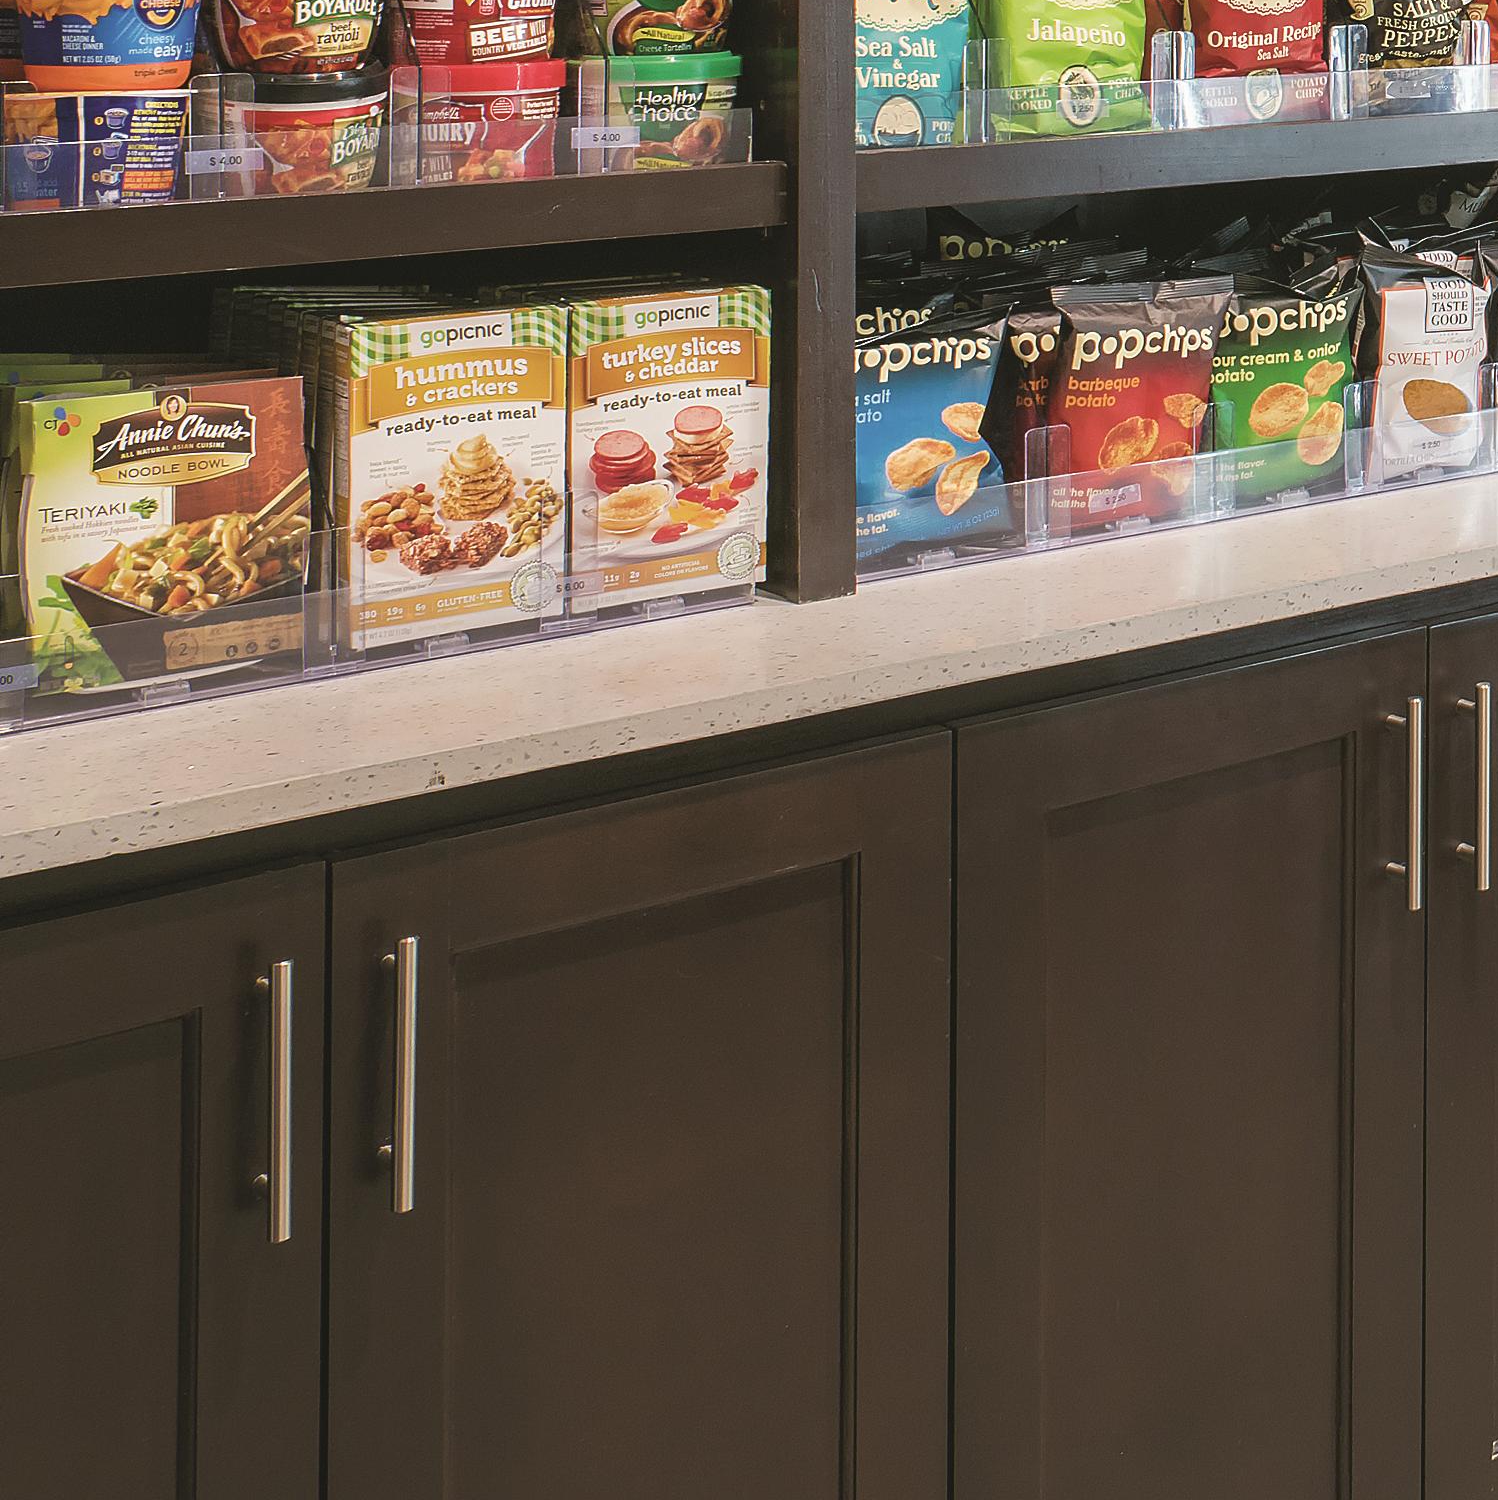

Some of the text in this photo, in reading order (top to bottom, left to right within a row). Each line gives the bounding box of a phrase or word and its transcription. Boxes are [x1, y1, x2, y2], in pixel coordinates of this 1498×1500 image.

[331, 22, 352, 33] beef
[1027, 18, 1126, 46] Jalapeño
[1377, 14, 1419, 30] FRESH
[317, 30, 359, 46] ravioli
[470, 20, 546, 46] BEEF WITH
[902, 37, 937, 59] Salt
[1432, 290, 1468, 300] SHOULD
[1432, 301, 1468, 312] TASTE
[1431, 313, 1468, 326] GOOD
[602, 337, 741, 370] turkey slices
[1072, 324, 1213, 370] popchips
[1240, 349, 1304, 367] cream &
[395, 356, 528, 389] hummus
[624, 358, 719, 383] & cheddar
[406, 381, 518, 408] & crackers
[1068, 376, 1140, 392] barbeque
[603, 384, 742, 413] ready-to-eat meal
[865, 389, 891, 406] salt
[1066, 394, 1116, 408] potato
[386, 406, 537, 437] ready-to-eat meal
[95, 415, 250, 461] Annie Chun's
[118, 459, 230, 479] NOODLE BOWL
